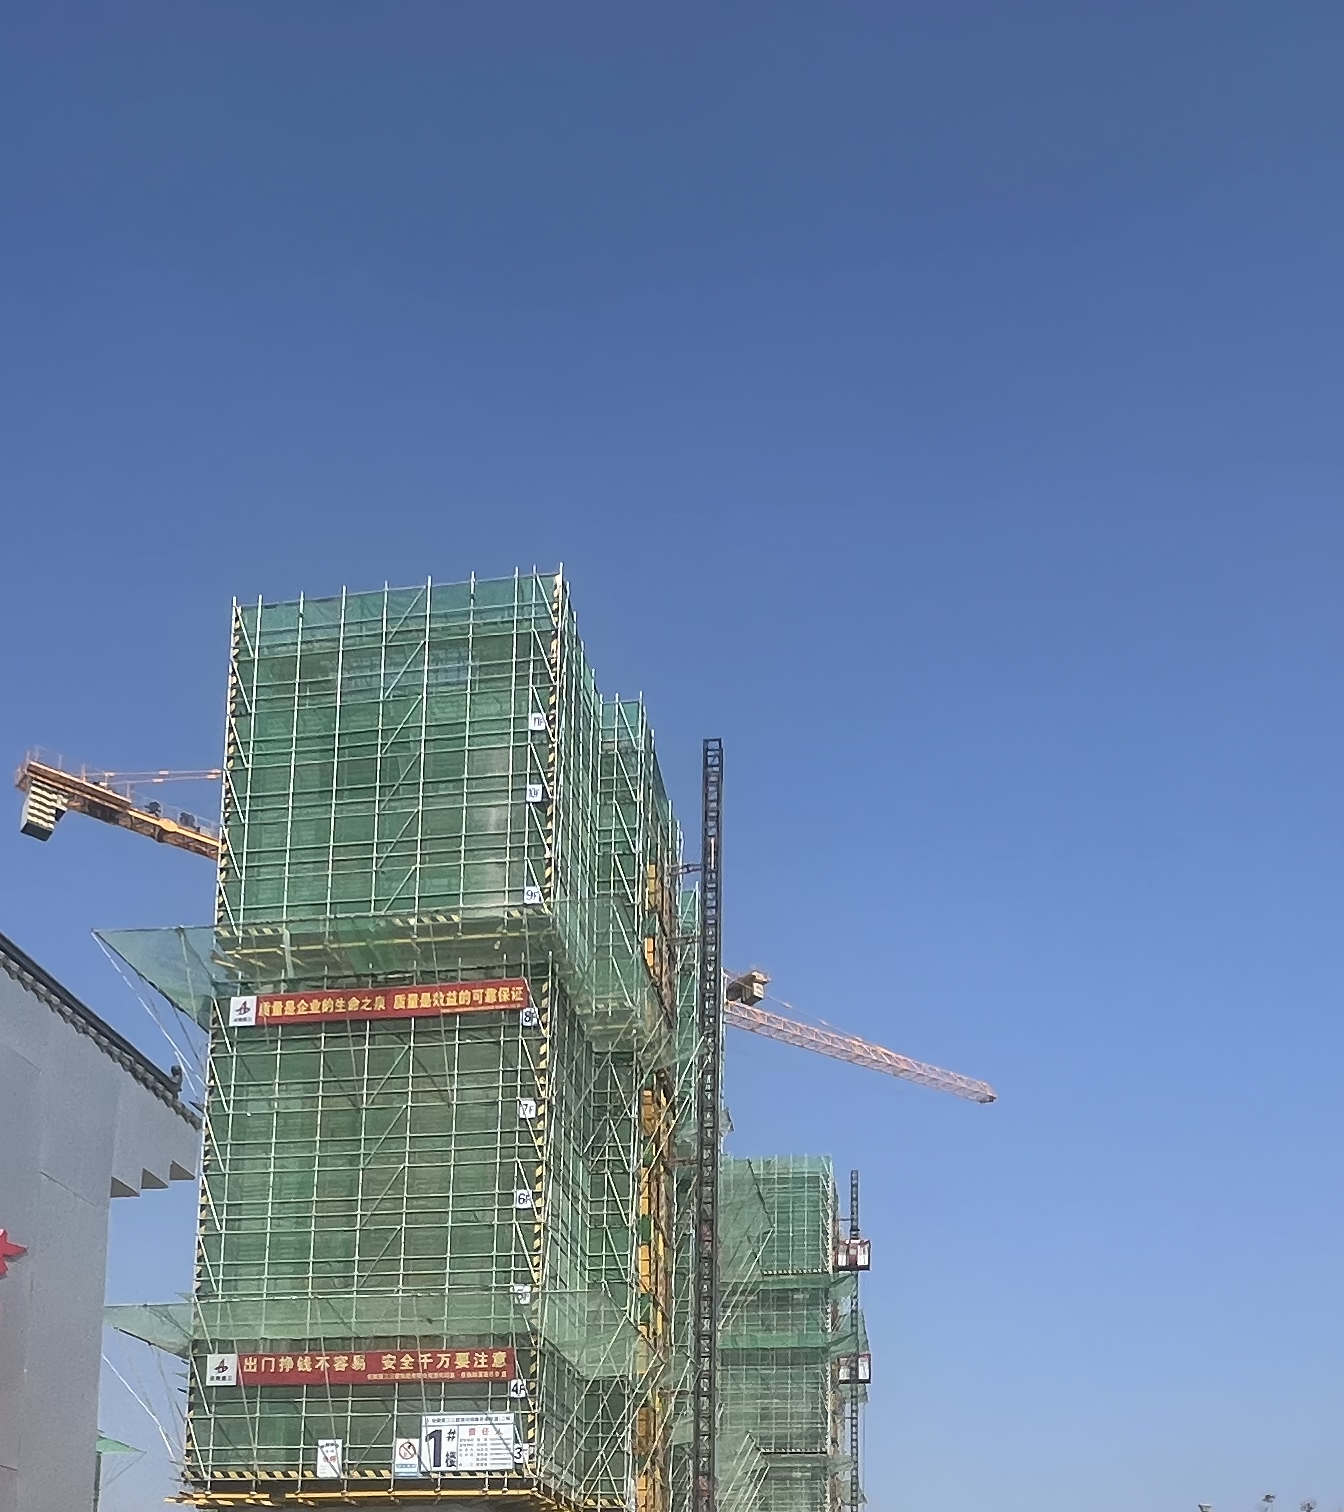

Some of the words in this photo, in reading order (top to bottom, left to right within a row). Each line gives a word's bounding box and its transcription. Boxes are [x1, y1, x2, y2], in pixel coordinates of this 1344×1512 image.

[392, 986, 524, 1010] 质量是效益的可靠保证
[243, 1354, 366, 1374] 出门挣钱不容易
[382, 1350, 508, 1371] 安全千万要注意
